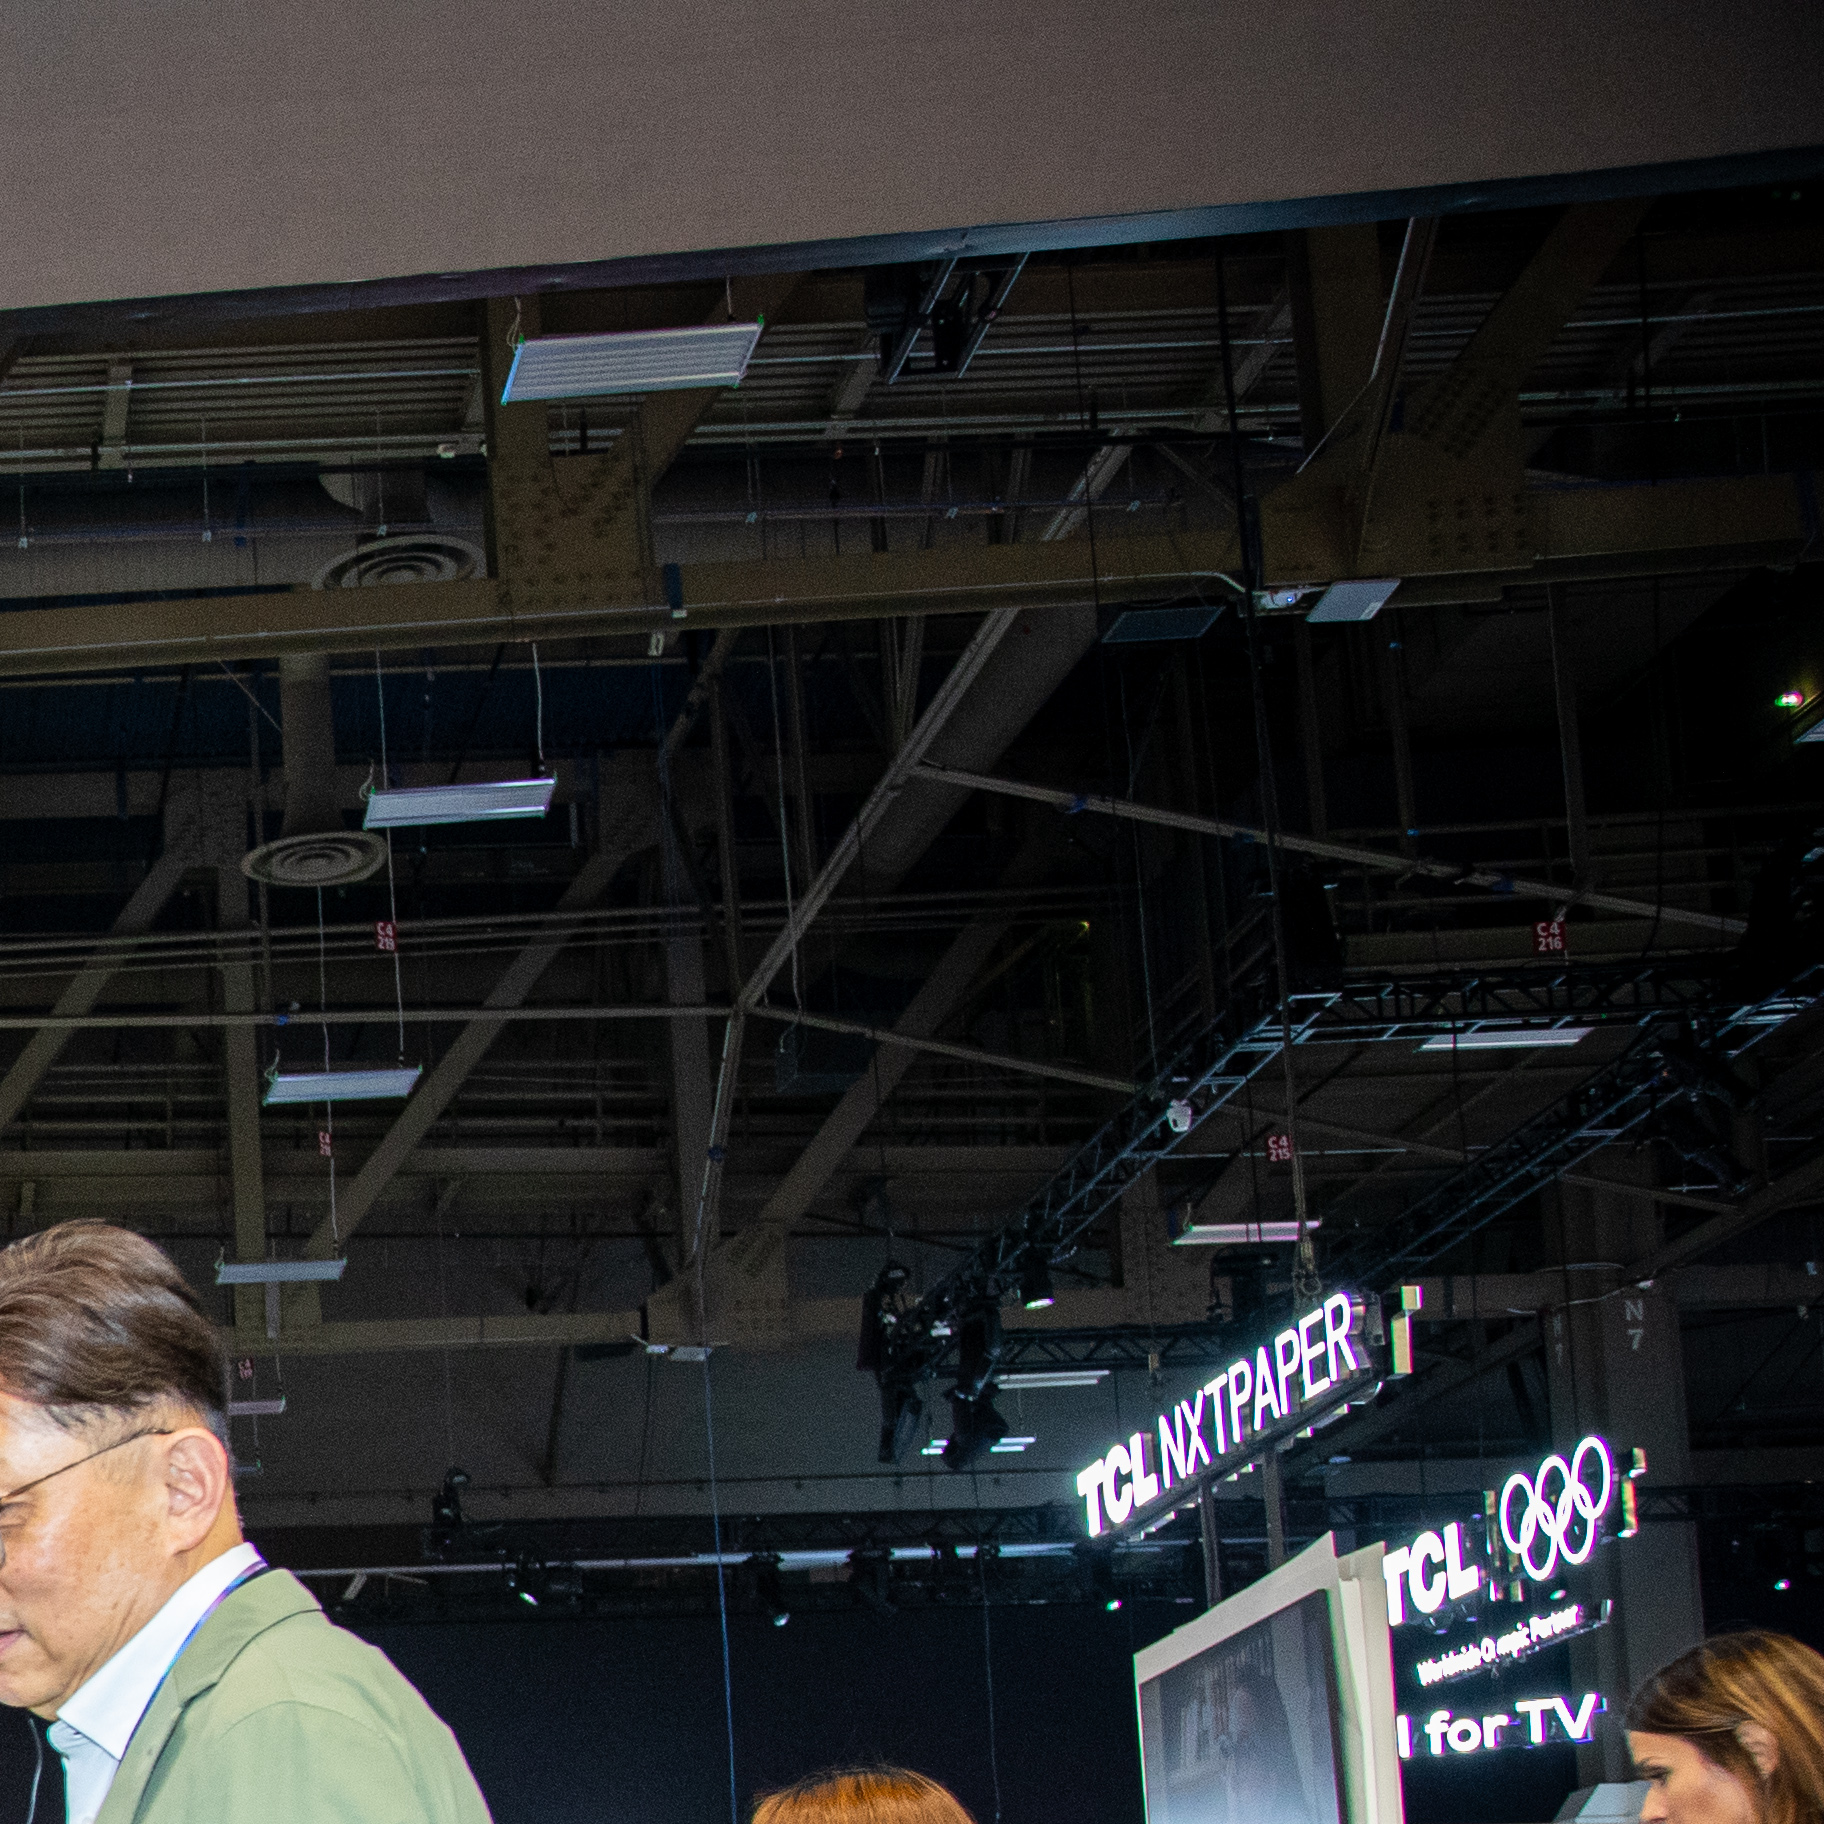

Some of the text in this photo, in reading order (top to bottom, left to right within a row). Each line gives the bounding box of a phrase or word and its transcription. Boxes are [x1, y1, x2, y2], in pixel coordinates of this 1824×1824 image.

[1537, 922, 1560, 936] C4
[1538, 936, 1563, 951] 216
[1267, 1135, 1289, 1148] C4
[1077, 1290, 1358, 1538] TCL NXTPAPER
[1383, 1522, 1480, 1627] TCL
[1424, 1709, 1510, 1755] for
[1515, 1692, 1599, 1743] TV
